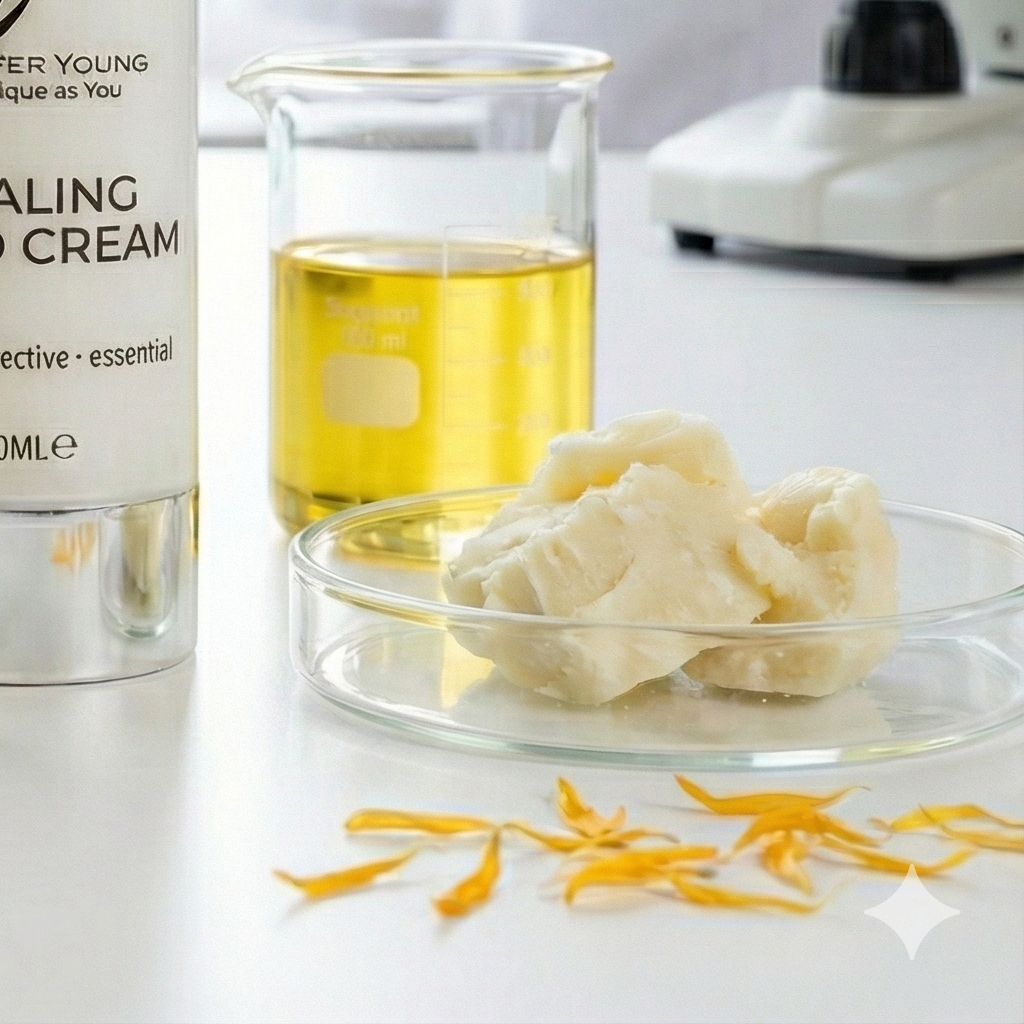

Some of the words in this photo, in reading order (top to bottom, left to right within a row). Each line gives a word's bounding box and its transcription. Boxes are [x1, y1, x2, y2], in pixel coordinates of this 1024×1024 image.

[54, 53, 149, 75] YOUNG
[54, 85, 78, 100] as
[83, 81, 122, 99] You
[22, 219, 179, 265] CREAM
[89, 334, 173, 368] essential
